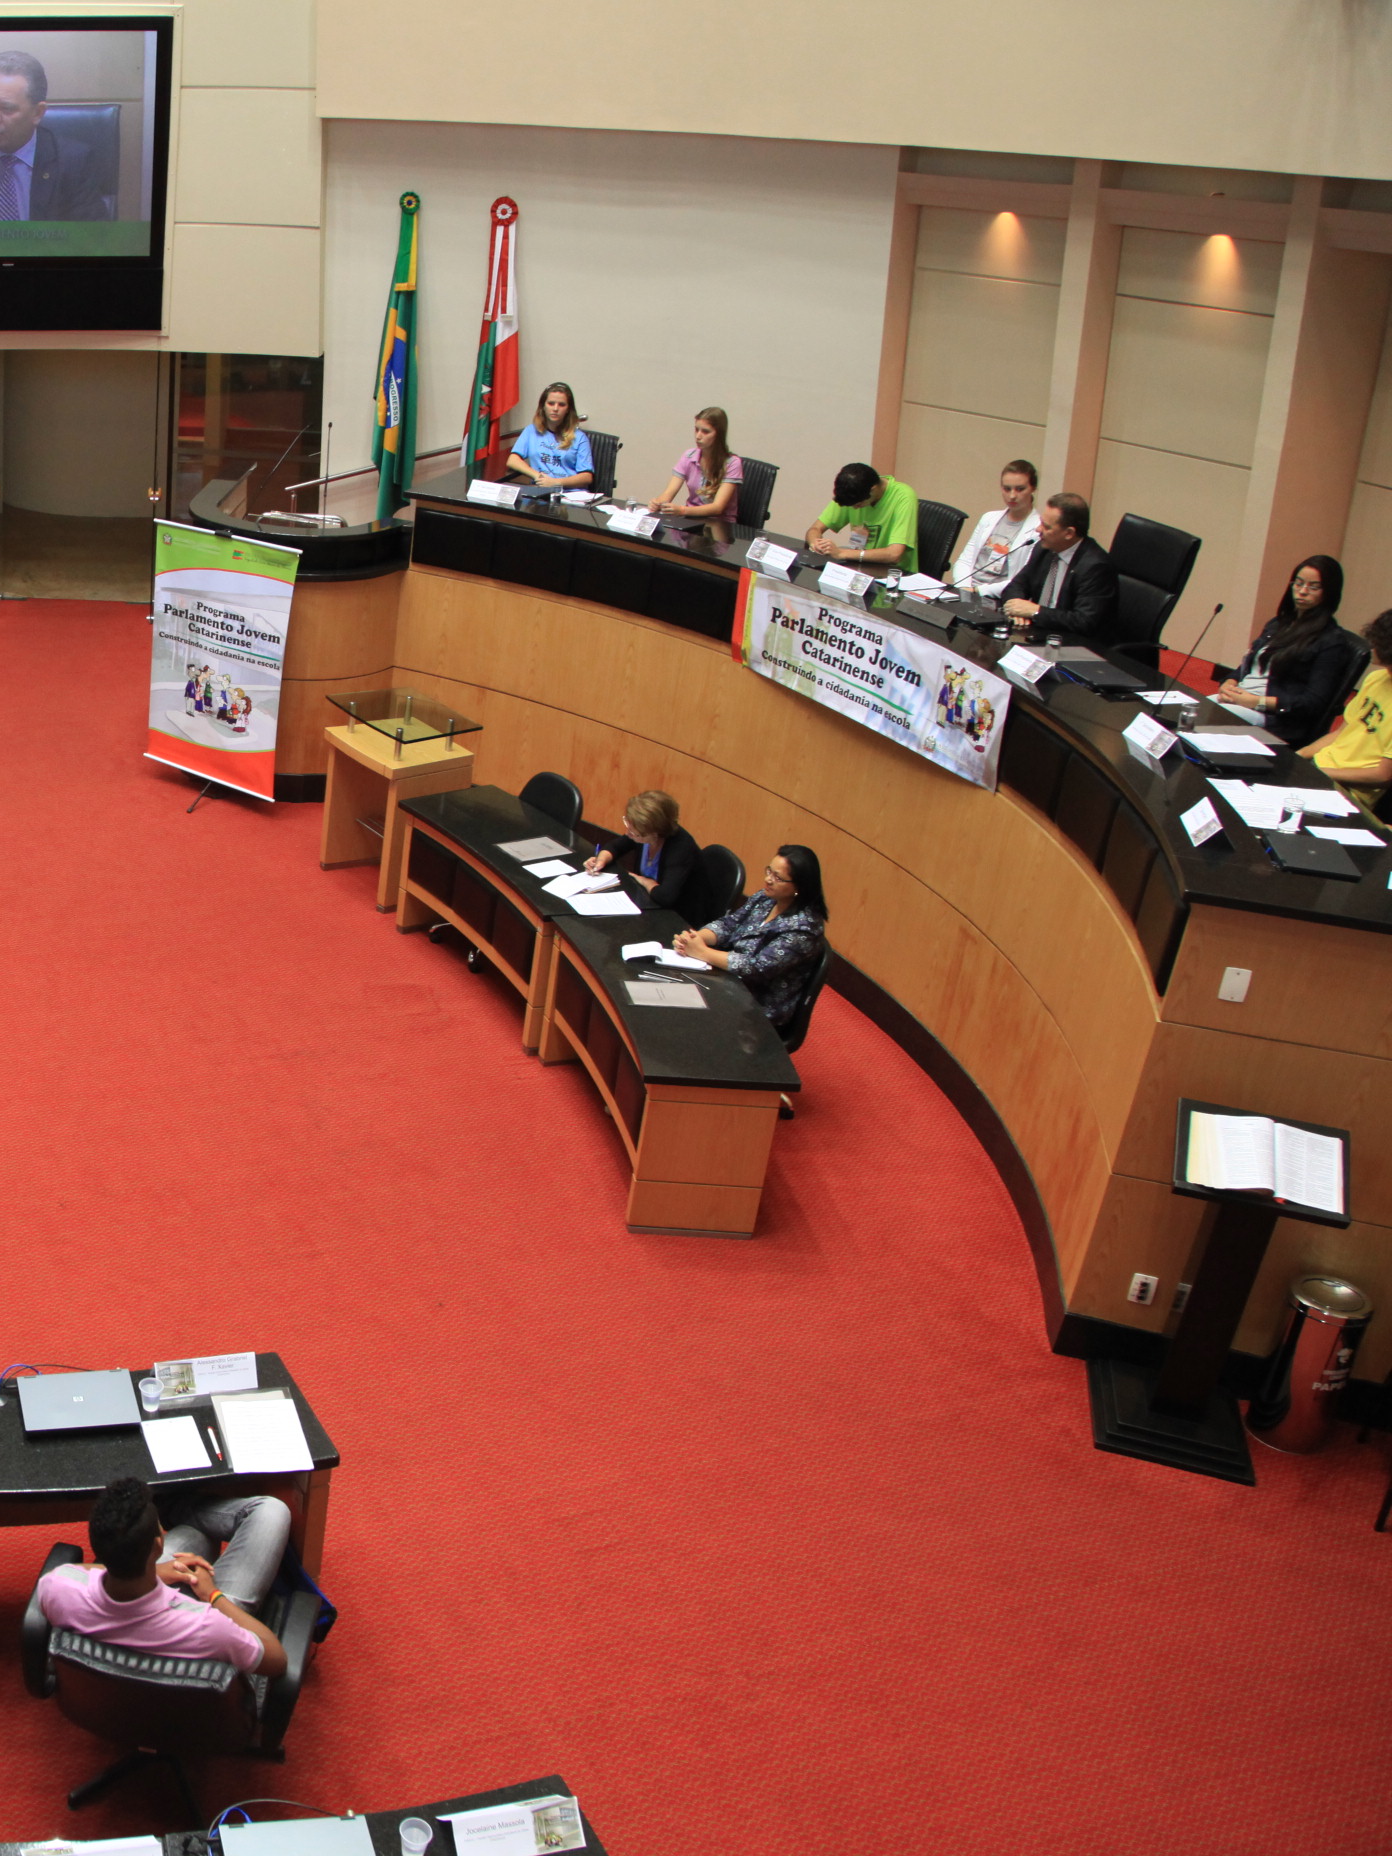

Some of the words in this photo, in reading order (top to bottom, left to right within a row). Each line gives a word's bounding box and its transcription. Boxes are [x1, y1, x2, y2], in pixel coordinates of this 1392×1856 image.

[163, 604, 233, 632] Parlamento
[237, 624, 281, 645] Jovem
[197, 602, 245, 623] Programa
[818, 607, 883, 646] Programa
[159, 632, 203, 650] Construindo
[209, 646, 245, 662] cidadania
[246, 657, 256, 665] na
[257, 659, 281, 671] escola
[188, 623, 252, 649] Catarinense
[770, 607, 865, 659] Parlamento
[869, 649, 922, 688] Jovem
[802, 640, 885, 689] Catarinense
[762, 650, 817, 682] Construindo
[817, 678, 824, 686] a
[825, 680, 870, 709] cidadania
[871, 703, 883, 715] na
[884, 709, 911, 730] escola
